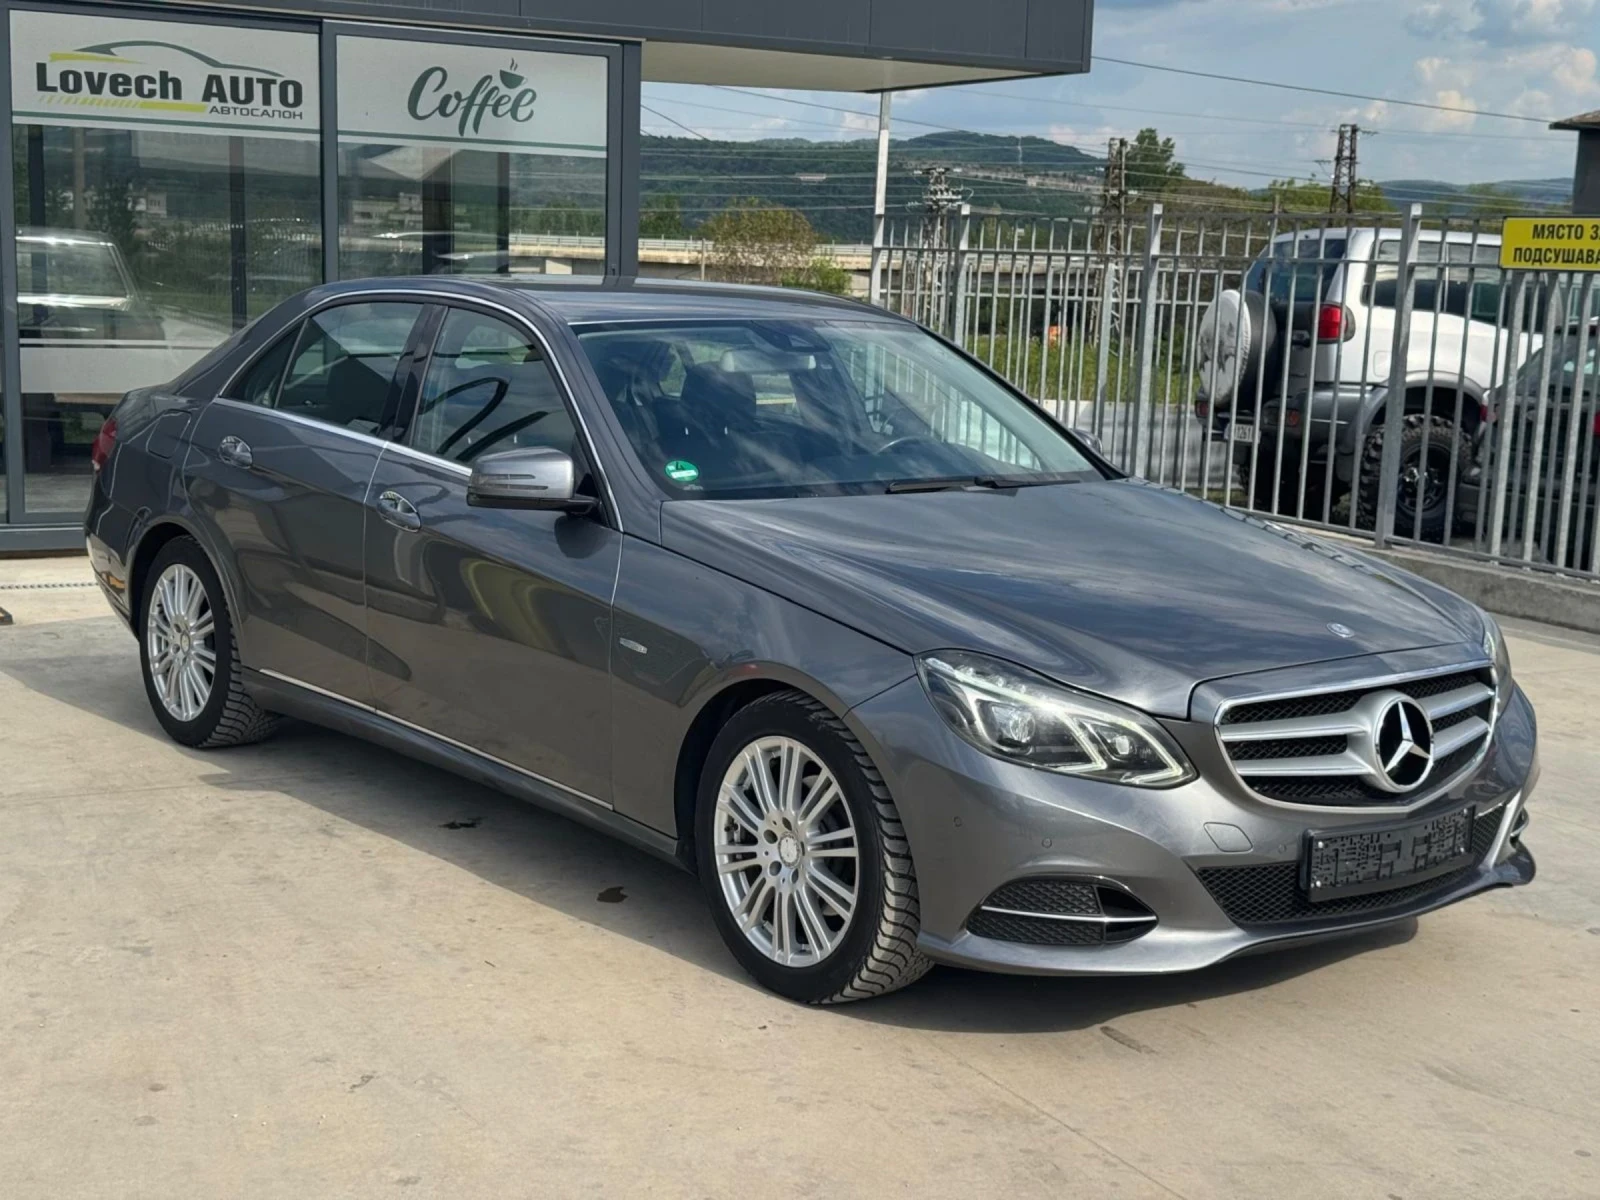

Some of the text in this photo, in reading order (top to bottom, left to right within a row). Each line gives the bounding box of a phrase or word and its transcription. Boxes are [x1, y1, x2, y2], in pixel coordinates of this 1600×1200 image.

[36, 62, 303, 108] Lovech AUTO
[208, 106, 303, 120] АВТОСАЛОН
[407, 66, 537, 137] Coffee
[1532, 224, 1600, 240] МЯСТО З
